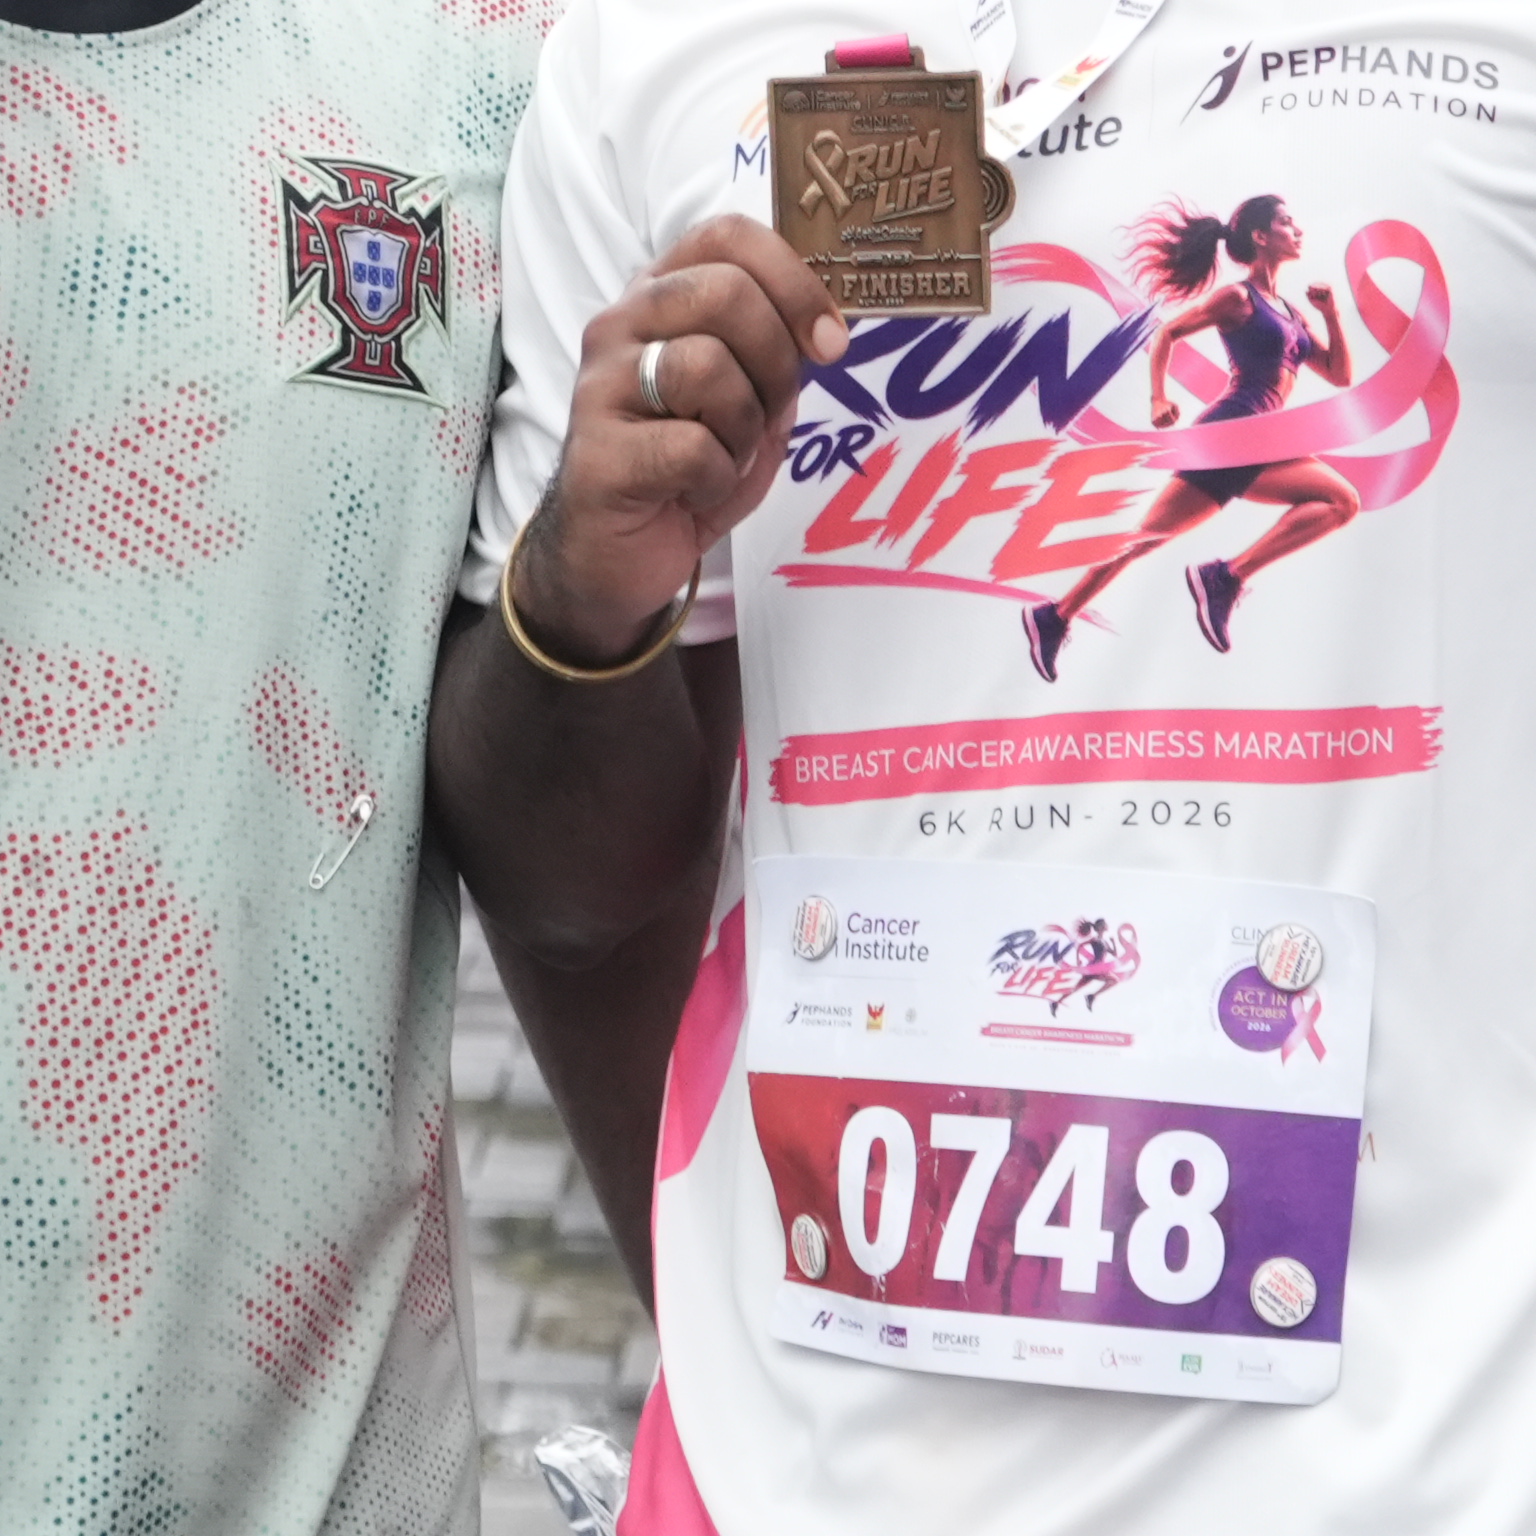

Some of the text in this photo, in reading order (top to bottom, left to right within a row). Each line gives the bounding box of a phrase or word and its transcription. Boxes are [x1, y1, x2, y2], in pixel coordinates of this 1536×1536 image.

[1260, 44, 1500, 91] PEPHANDS
[1261, 87, 1498, 124] FOUNDATION
[843, 128, 941, 188] RUN
[852, 181, 877, 202] FOR
[873, 165, 953, 218] LIFE
[842, 271, 971, 299] FINISHER
[800, 297, 1163, 443] RUN
[802, 428, 1168, 583] LIFE
[795, 749, 893, 784] BREAST
[1214, 726, 1395, 761] MARATHON
[920, 809, 966, 837] 6K
[1120, 799, 1234, 828] 2026
[847, 912, 920, 936] Cancer
[845, 938, 929, 962] Institute
[988, 929, 1076, 965] RUN
[1281, 943, 1300, 979] DREAM
[1003, 965, 1075, 999] LIFE
[1233, 990, 1288, 1006] ACT IN
[801, 1017, 852, 1028] FOUNDATION
[802, 1004, 853, 1018] PEPHANDS
[1231, 1004, 1287, 1020] OCTOBER
[1247, 1021, 1272, 1032] 2026
[837, 1105, 1230, 1306] 0748
[932, 1331, 980, 1347] PEPCARES
[1030, 1345, 1064, 1355] SUDAR
